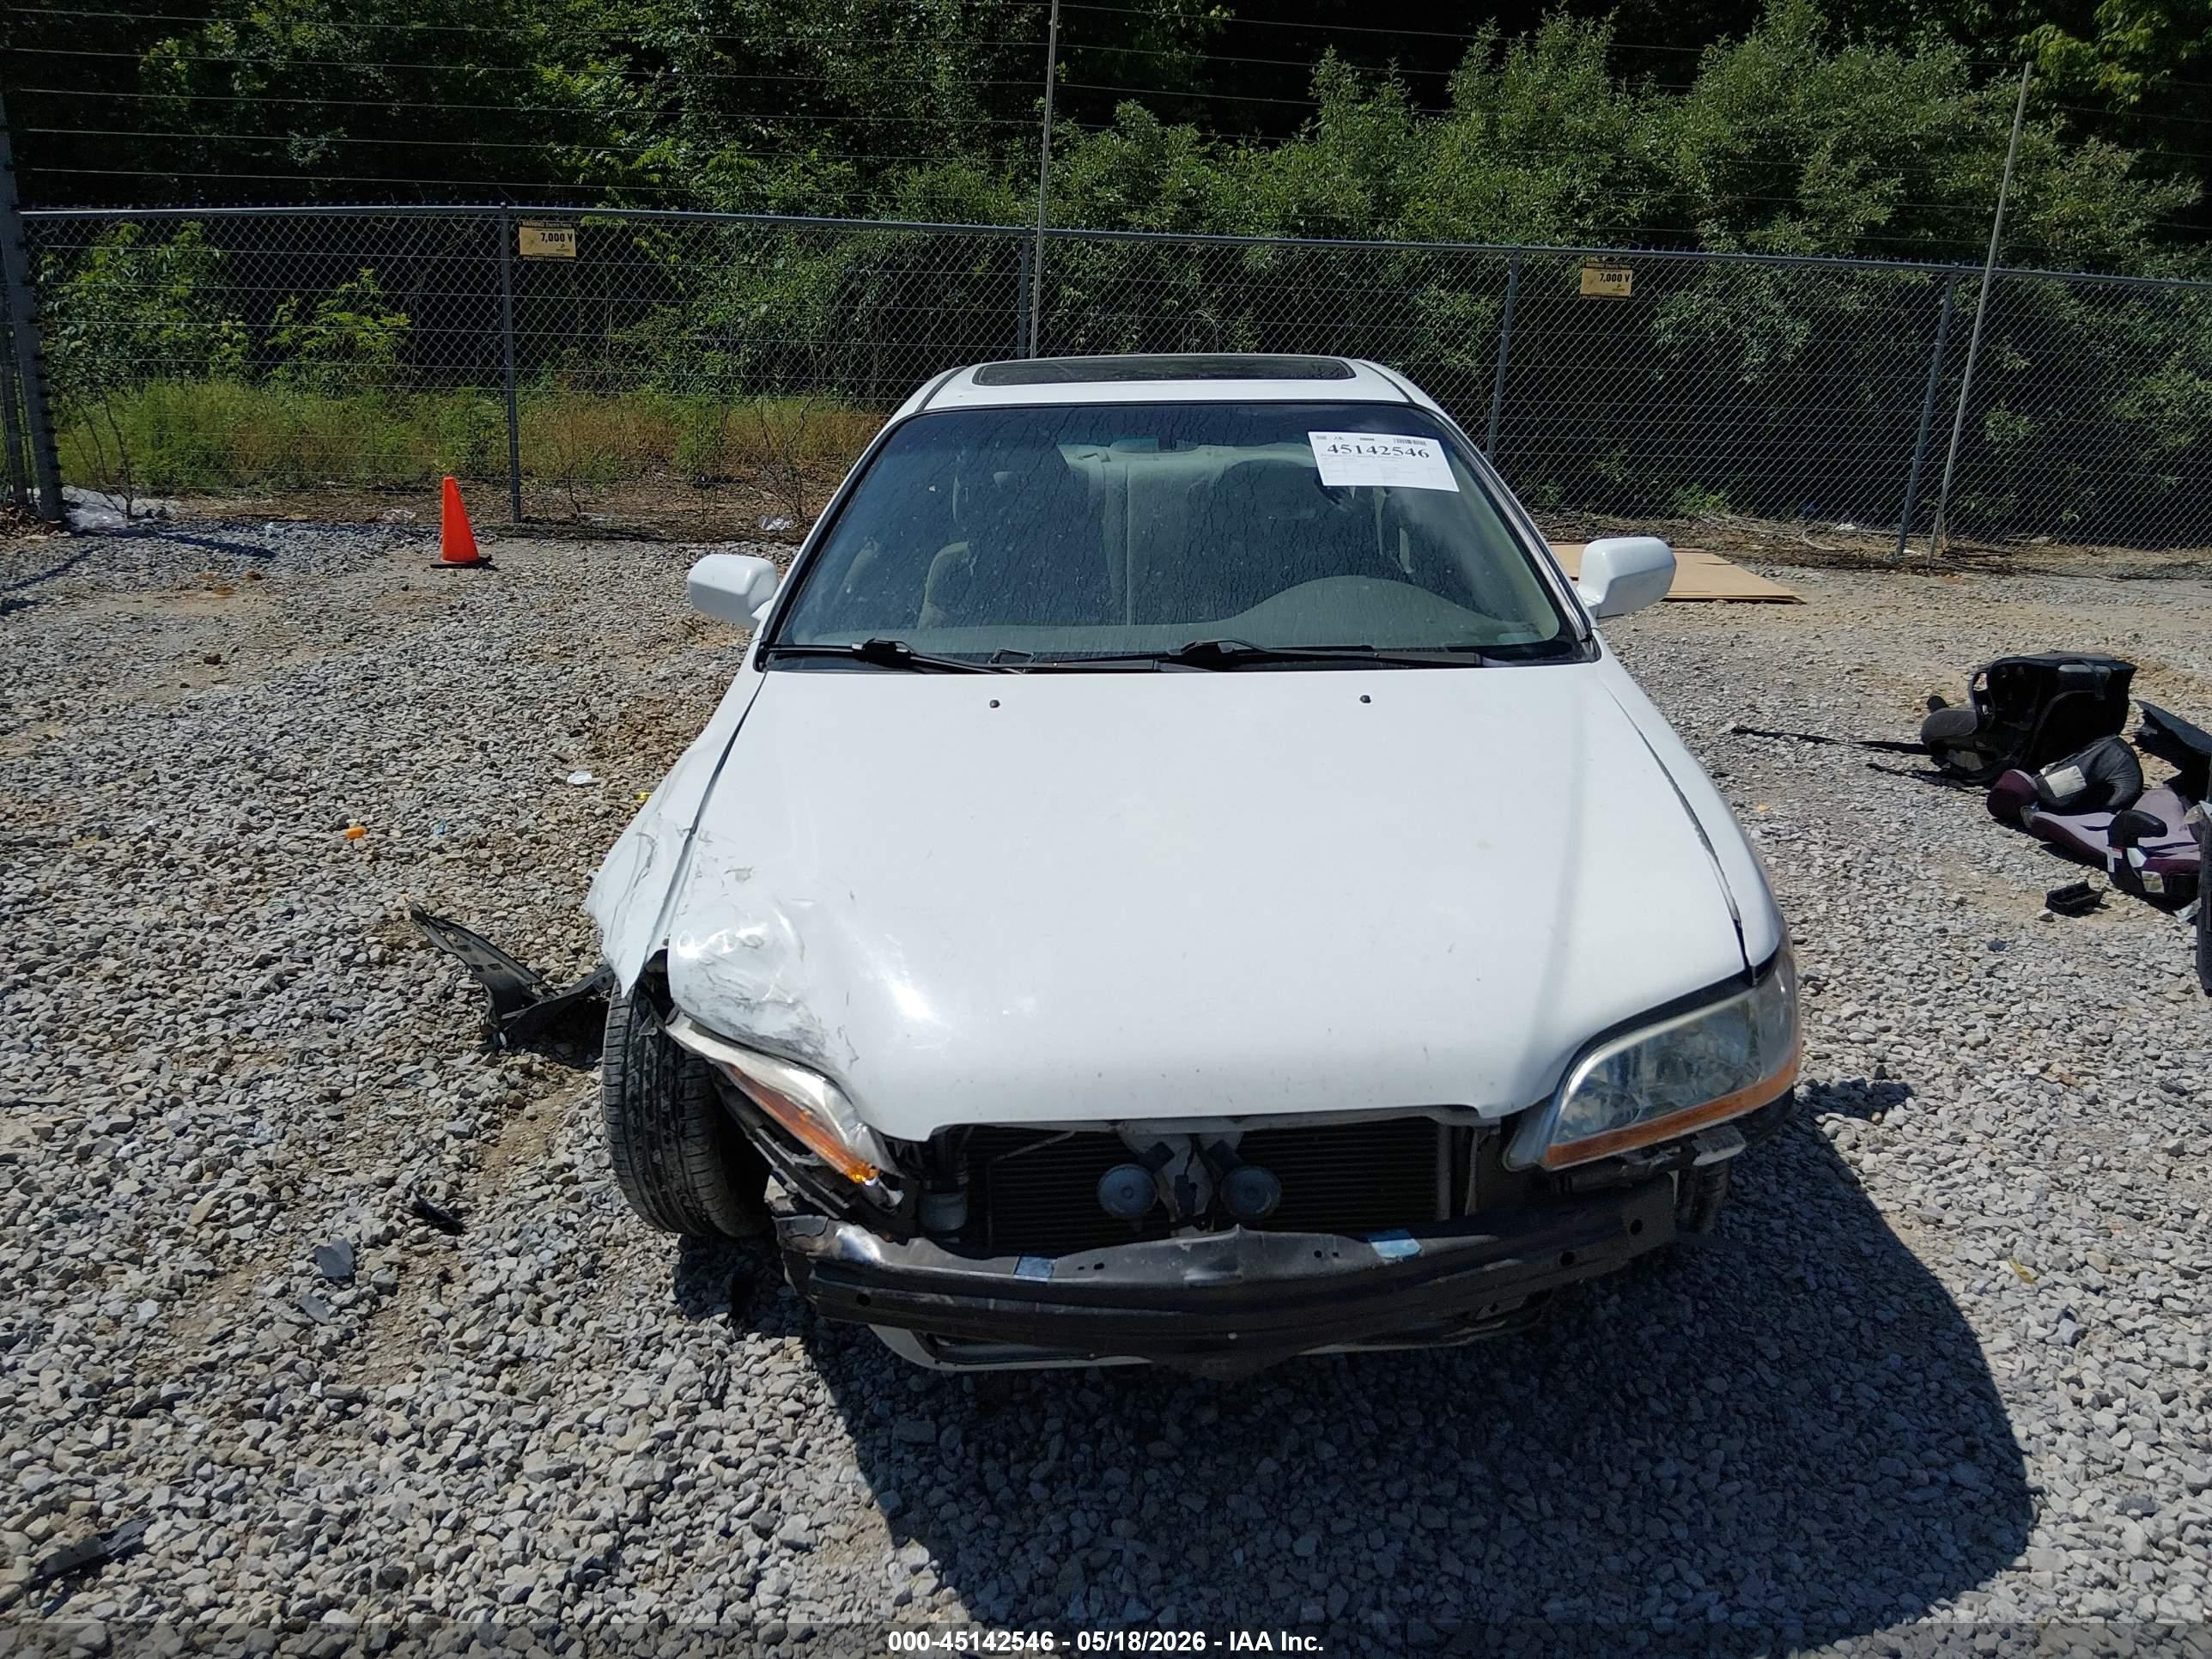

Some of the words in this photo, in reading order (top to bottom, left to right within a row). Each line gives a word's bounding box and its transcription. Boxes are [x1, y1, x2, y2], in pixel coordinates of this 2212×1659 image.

[540, 233, 565, 243] 7,000
[567, 233, 573, 242] V
[1600, 273, 1622, 283] 7,000
[1625, 273, 1631, 283] V
[1327, 443, 1430, 459] 45142546
